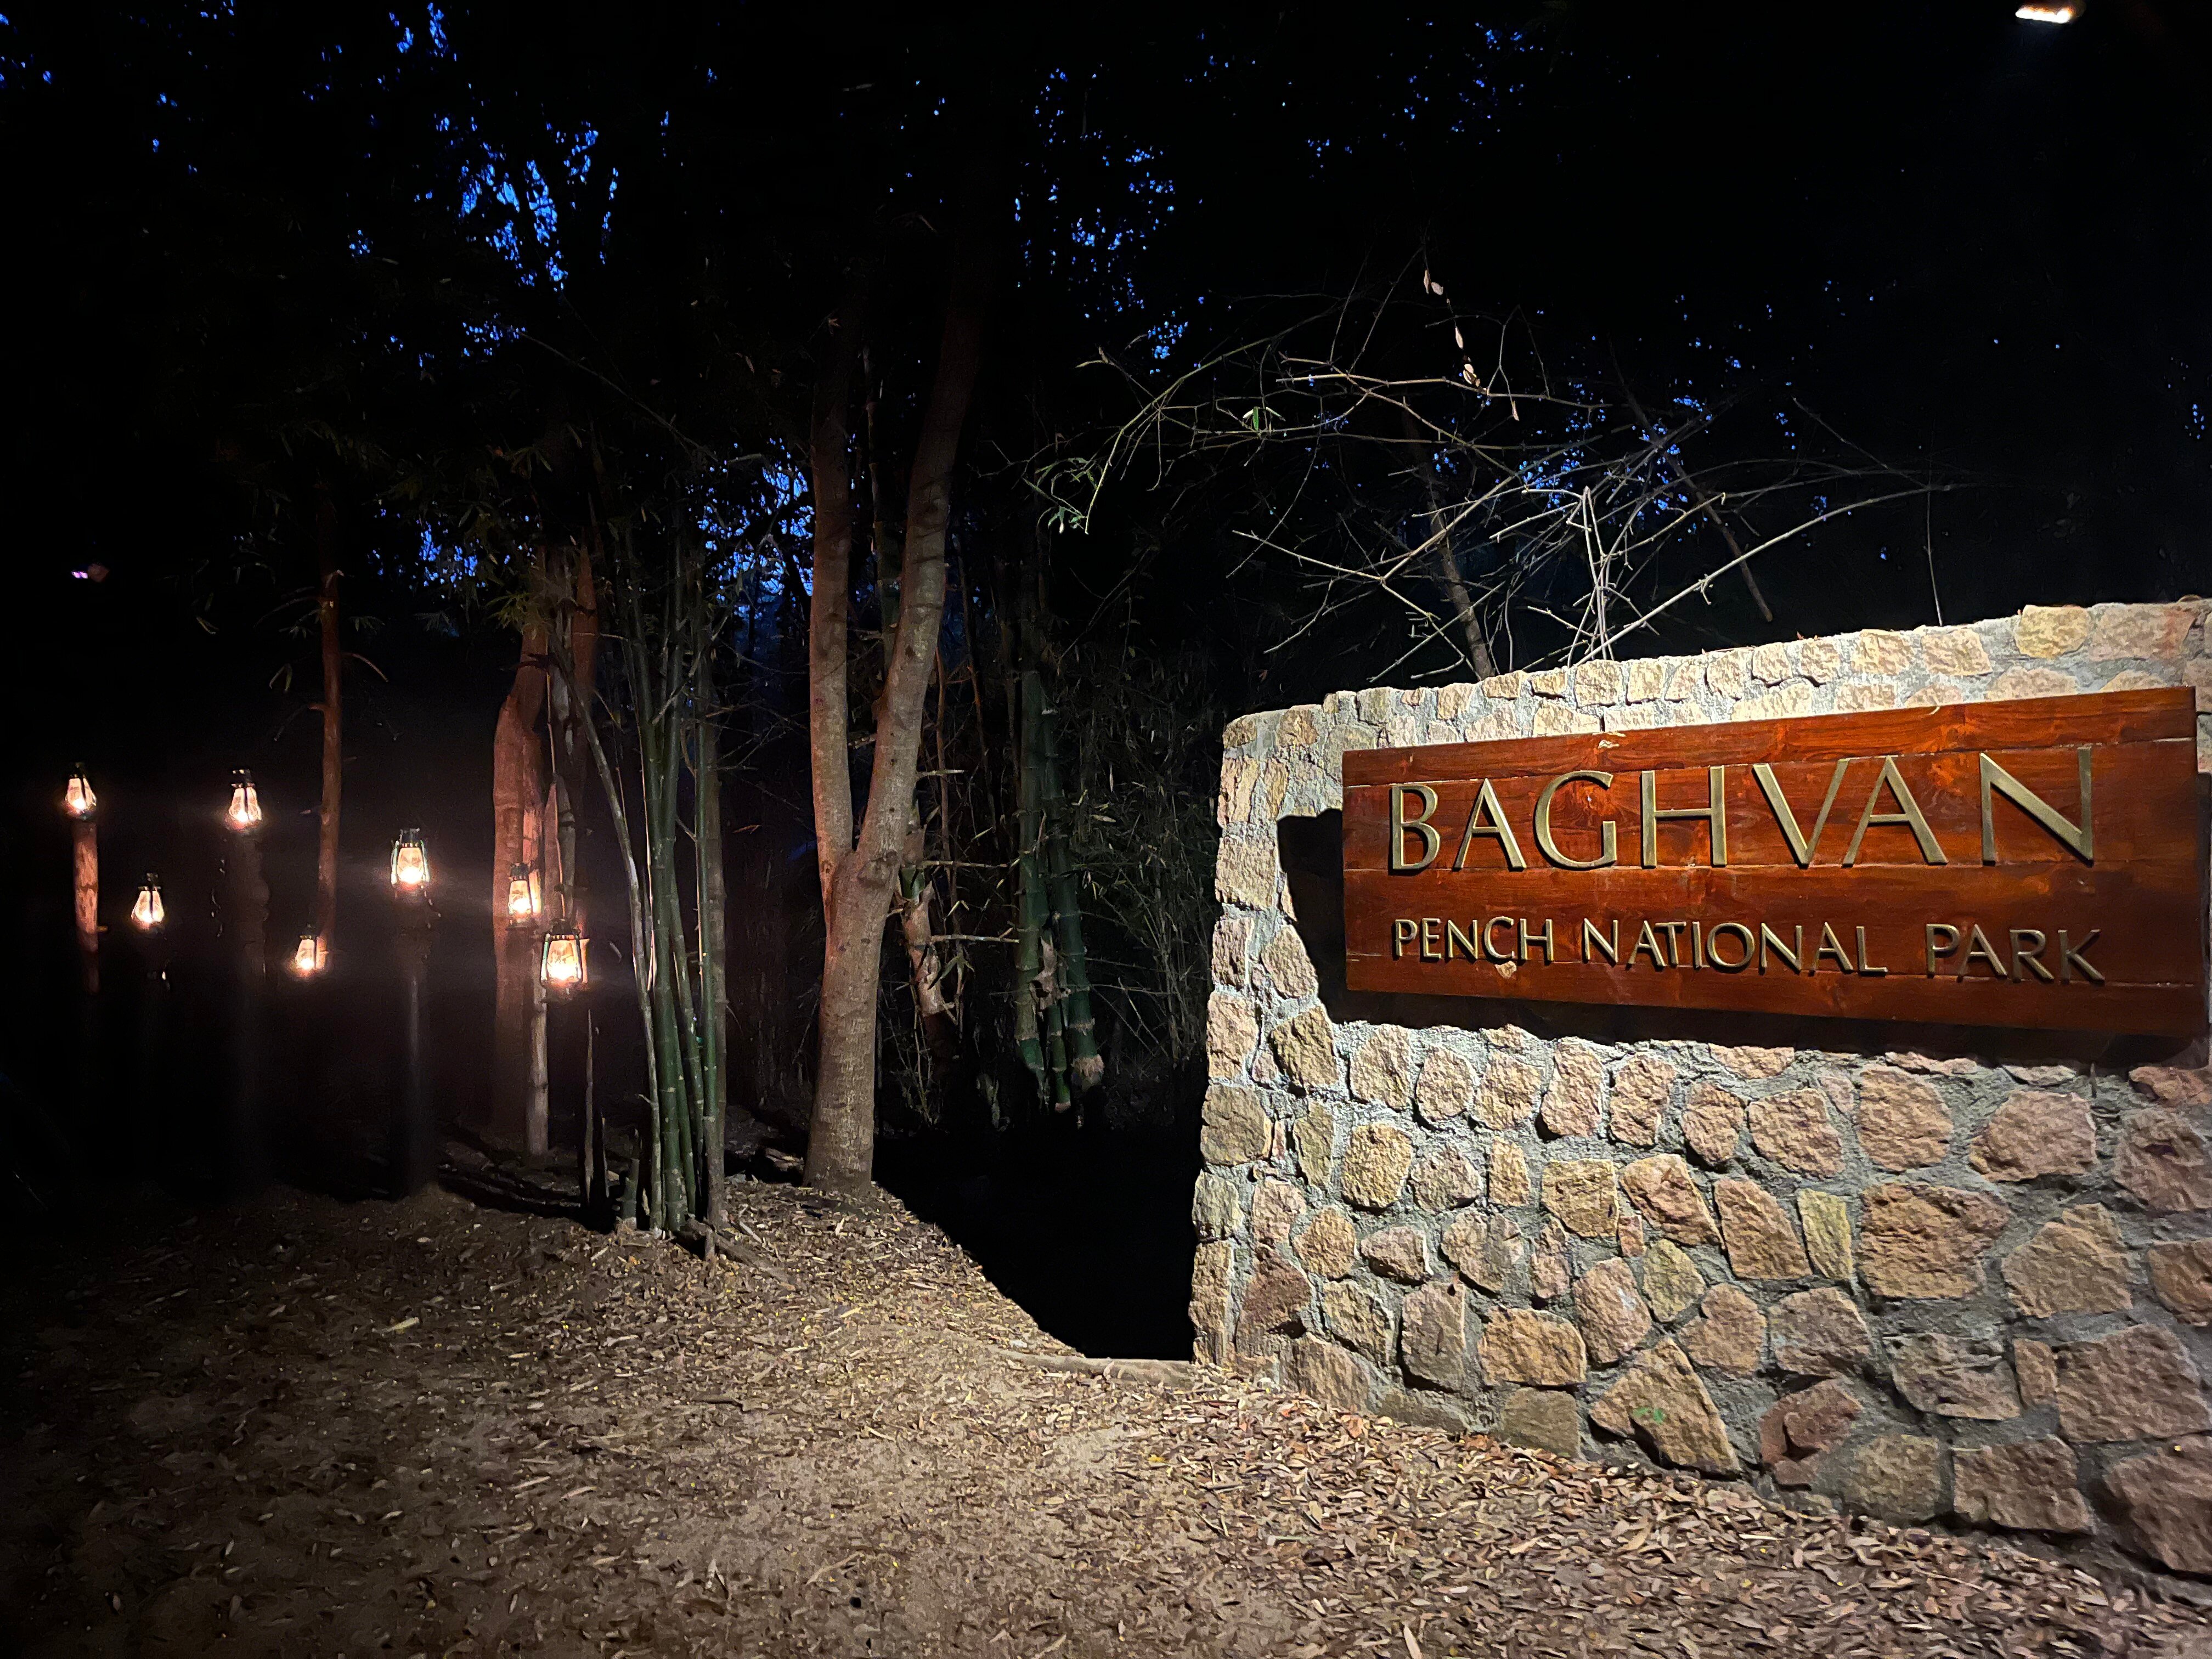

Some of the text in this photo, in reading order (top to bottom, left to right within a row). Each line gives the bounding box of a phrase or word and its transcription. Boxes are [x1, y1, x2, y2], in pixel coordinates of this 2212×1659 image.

[1390, 747, 2094, 870] BAGHVAN
[1394, 916, 2106, 983] PENCH NATIONAL PARK
